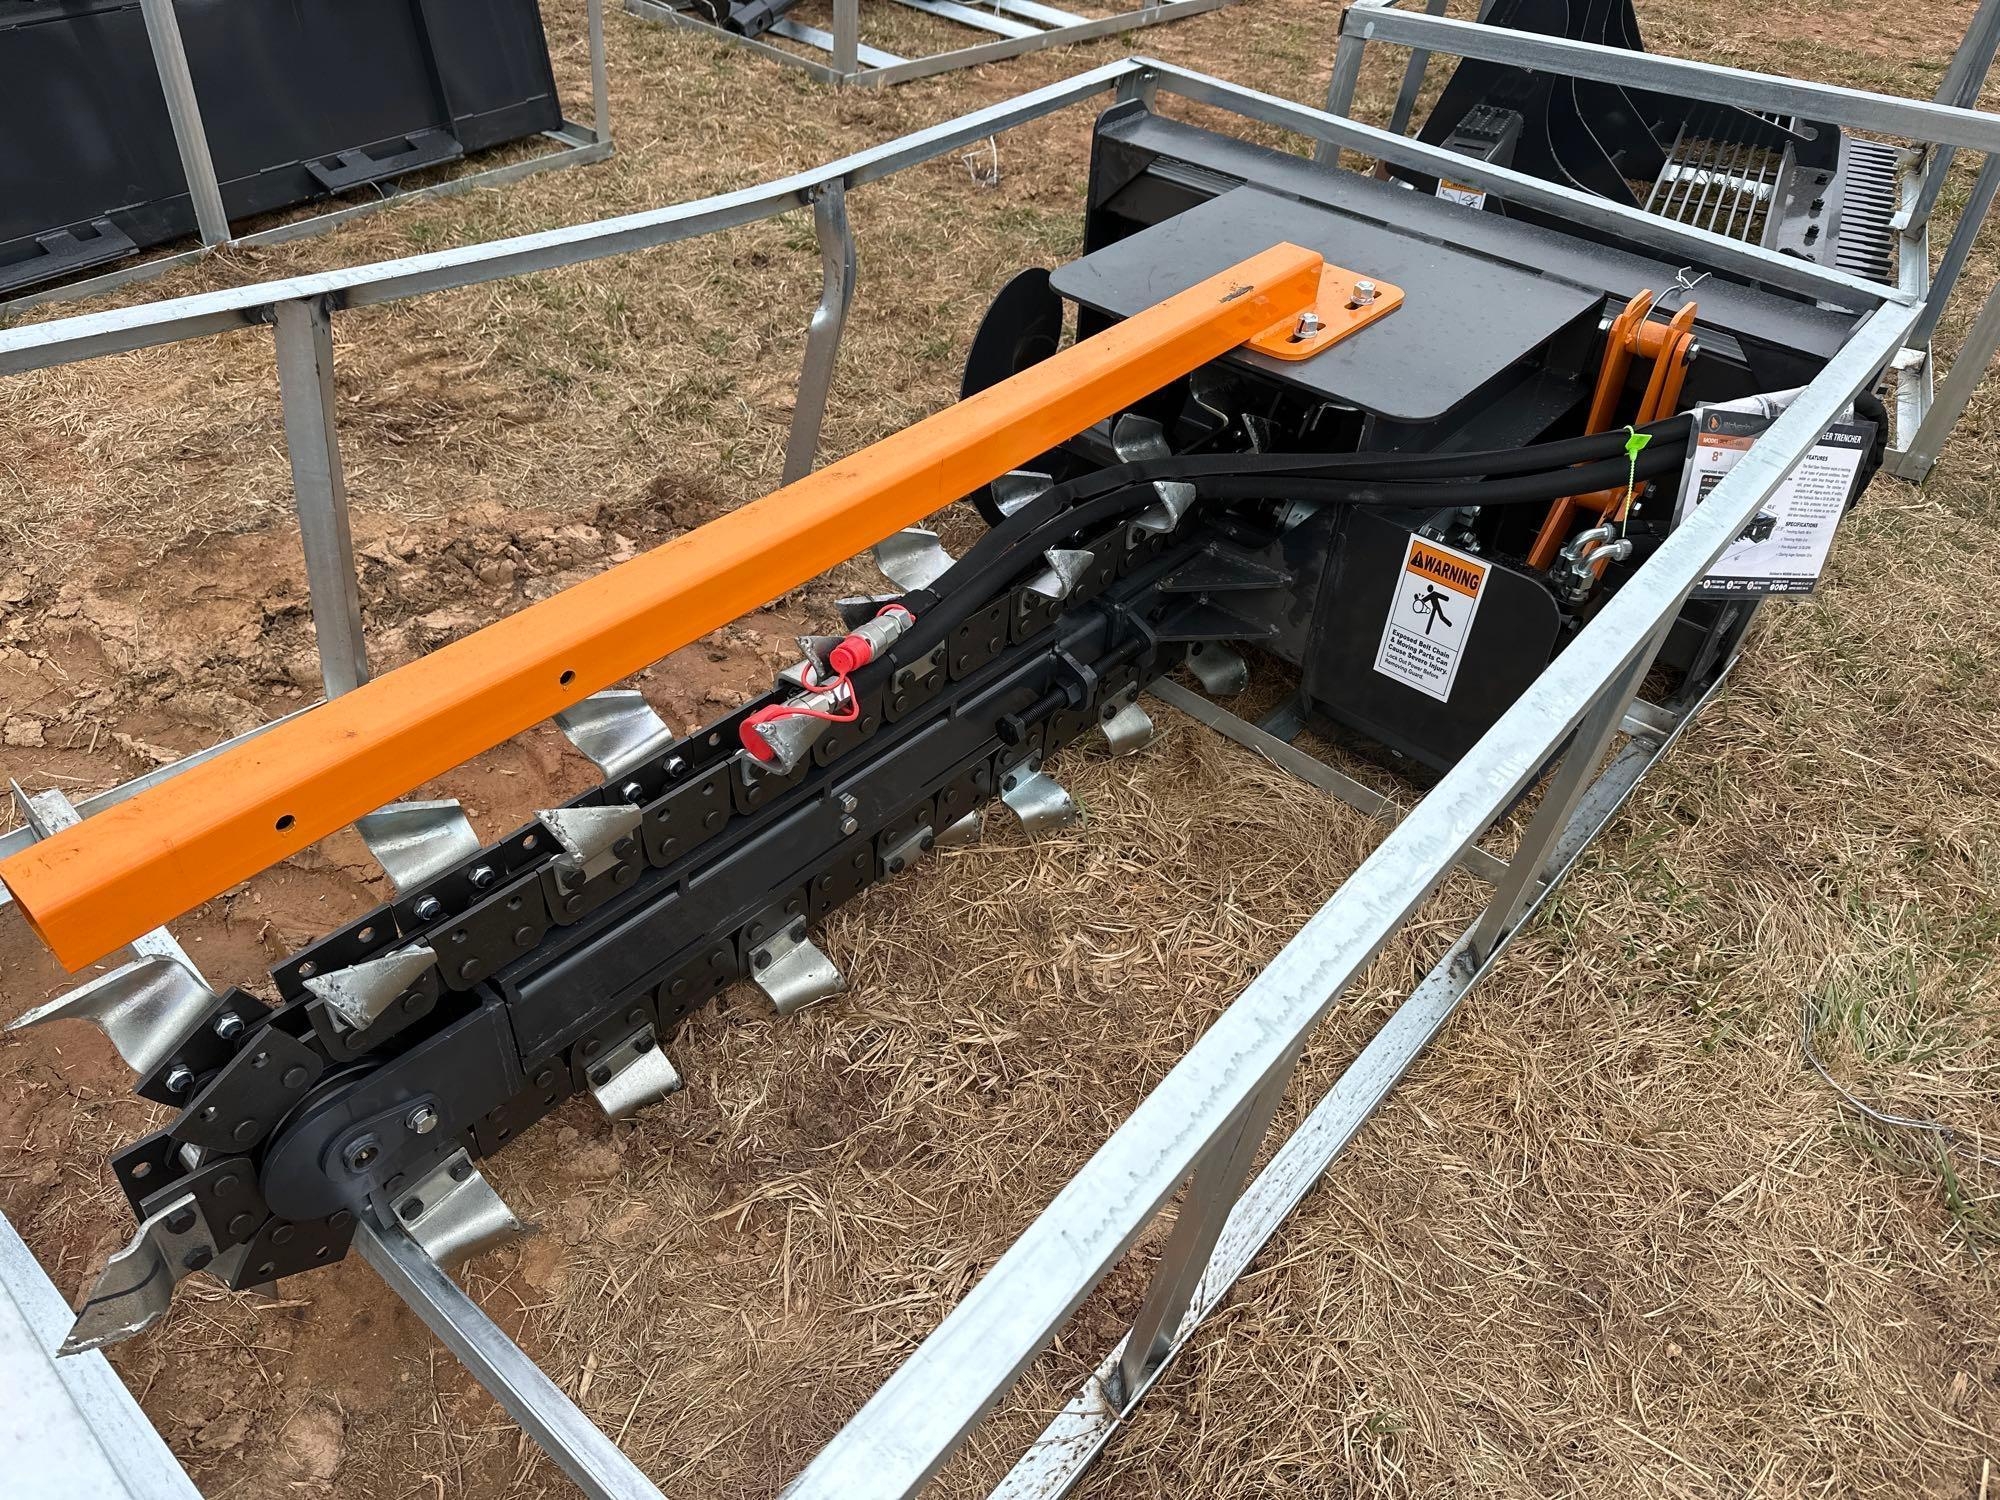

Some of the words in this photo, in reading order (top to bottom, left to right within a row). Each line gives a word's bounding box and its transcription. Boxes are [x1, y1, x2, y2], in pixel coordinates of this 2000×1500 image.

[1834, 433, 1862, 444] TRENCHER
[1806, 454, 1829, 462] FEATURES
[1785, 521, 1819, 529] SPECIFICATIONS
[1423, 554, 1480, 590] WARNING
[1392, 629, 1418, 645] Exposed
[1418, 640, 1431, 651] Belt
[1432, 647, 1450, 659] Chain
[1396, 639, 1418, 654] Moving
[1418, 649, 1435, 661] Parts
[1436, 657, 1448, 667] Can
[1384, 658, 1408, 674] Removing
[1386, 652, 1398, 661] Lock
[1398, 657, 1408, 666] Out
[1408, 661, 1423, 672] Power
[1423, 668, 1439, 680] Before
[1388, 643, 1407, 656] Cause
[1407, 652, 1428, 666] Severe
[1428, 662, 1448, 675] Injury.
